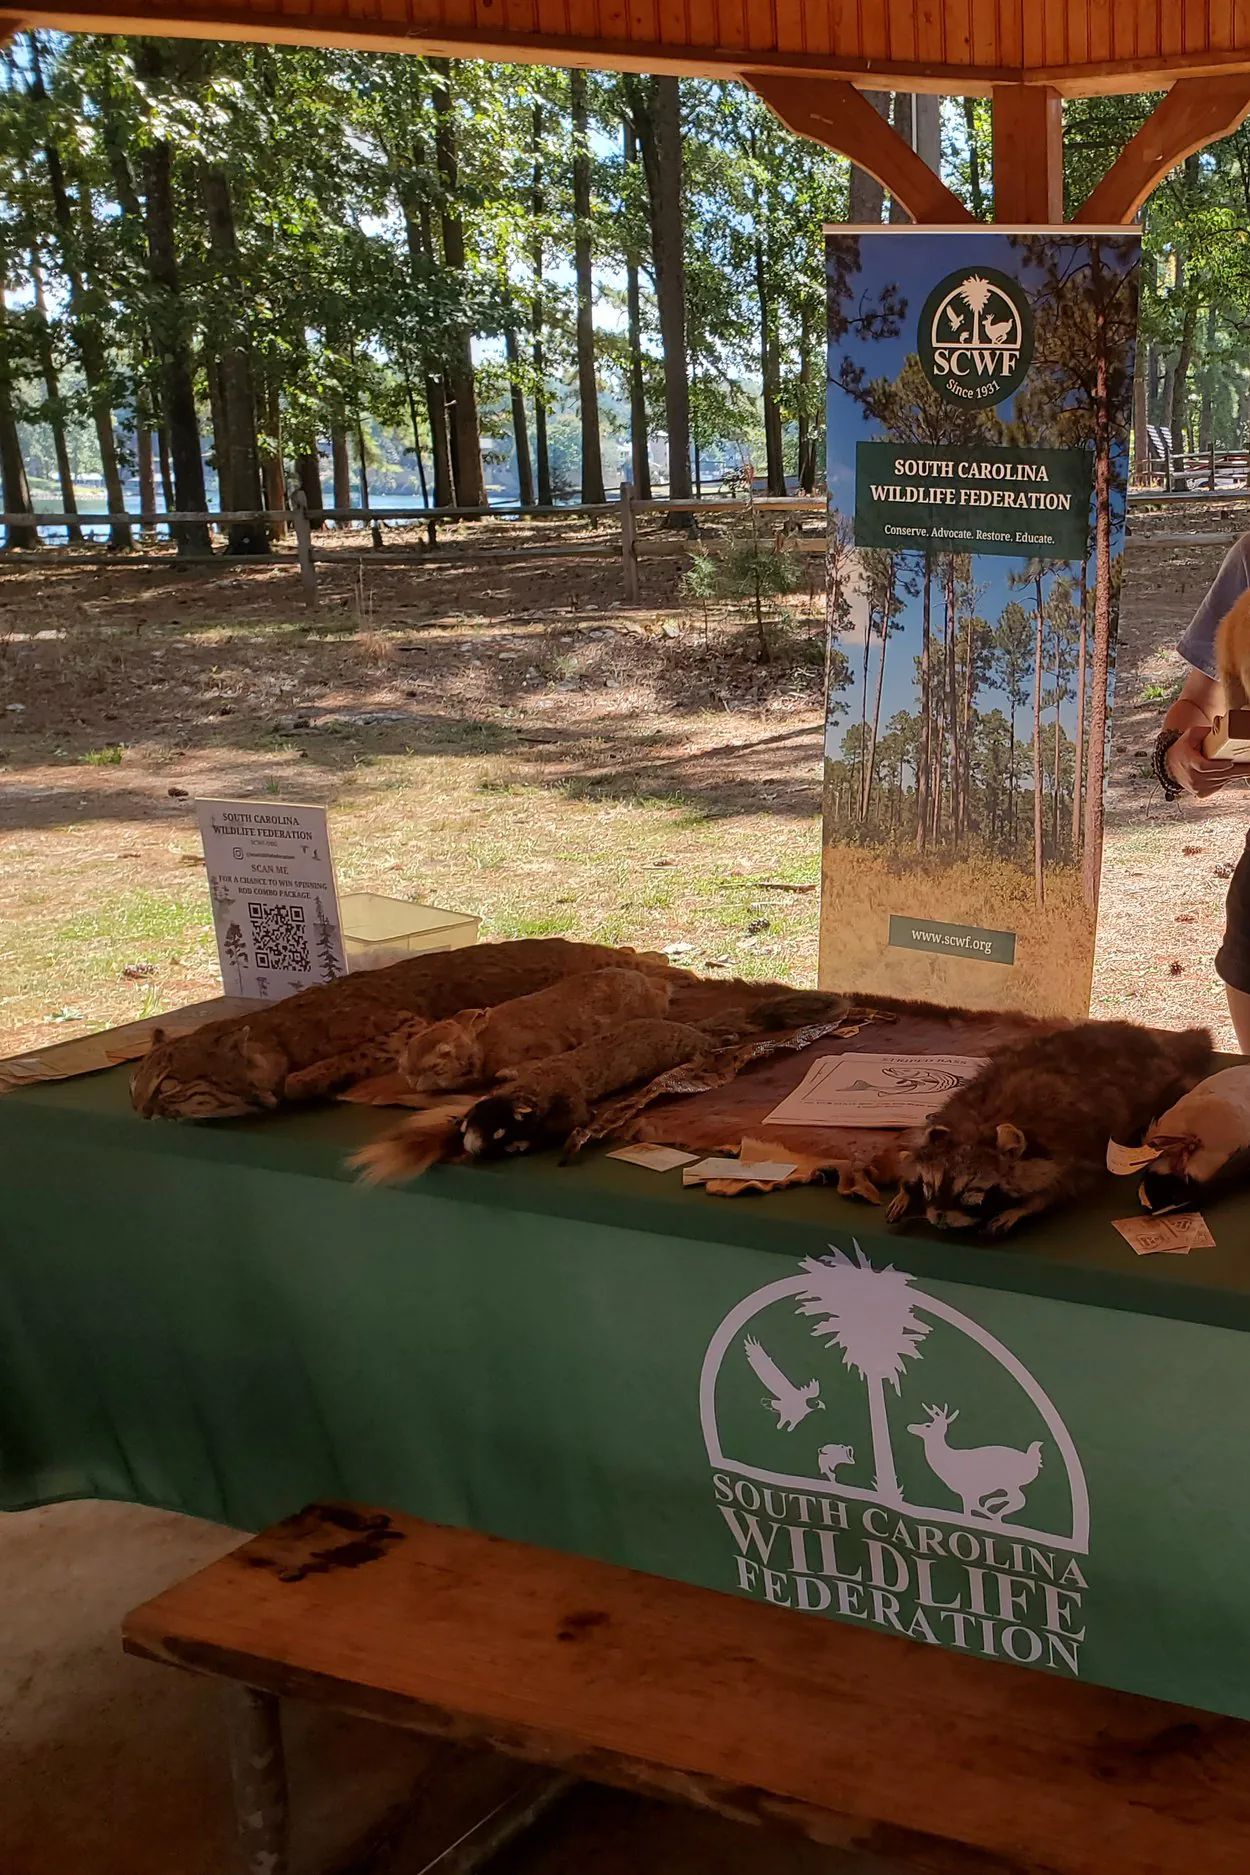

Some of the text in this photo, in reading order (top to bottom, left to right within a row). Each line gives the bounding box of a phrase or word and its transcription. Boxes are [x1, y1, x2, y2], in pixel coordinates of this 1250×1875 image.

[933, 349, 1020, 377] SCWF
[946, 378, 1001, 399] Since 1931
[894, 459, 1049, 482] SOUTH CAROLINA
[870, 485, 1071, 511] WILDLIFE FEDERATION
[884, 524, 1055, 545] Conserve. Advocate. Restore. Educate.
[223, 812, 300, 826] SOUTH CAROLINA
[212, 825, 313, 841] WILDLIFE FEDERATION
[251, 864, 289, 875] SCAN ME
[219, 875, 232, 883] FOR
[239, 876, 267, 886] CHANCE
[268, 878, 278, 886] TO
[279, 879, 293, 888] WIN
[294, 880, 328, 890] SPINNING
[238, 887, 311, 899] ROD COMBO PACKAGE
[912, 929, 992, 954] www.scwf.org
[712, 1473, 1089, 1589] SOUTH CAROLINA
[717, 1504, 1087, 1642] WILDLIFE
[732, 1554, 1081, 1677] FEDERATION
